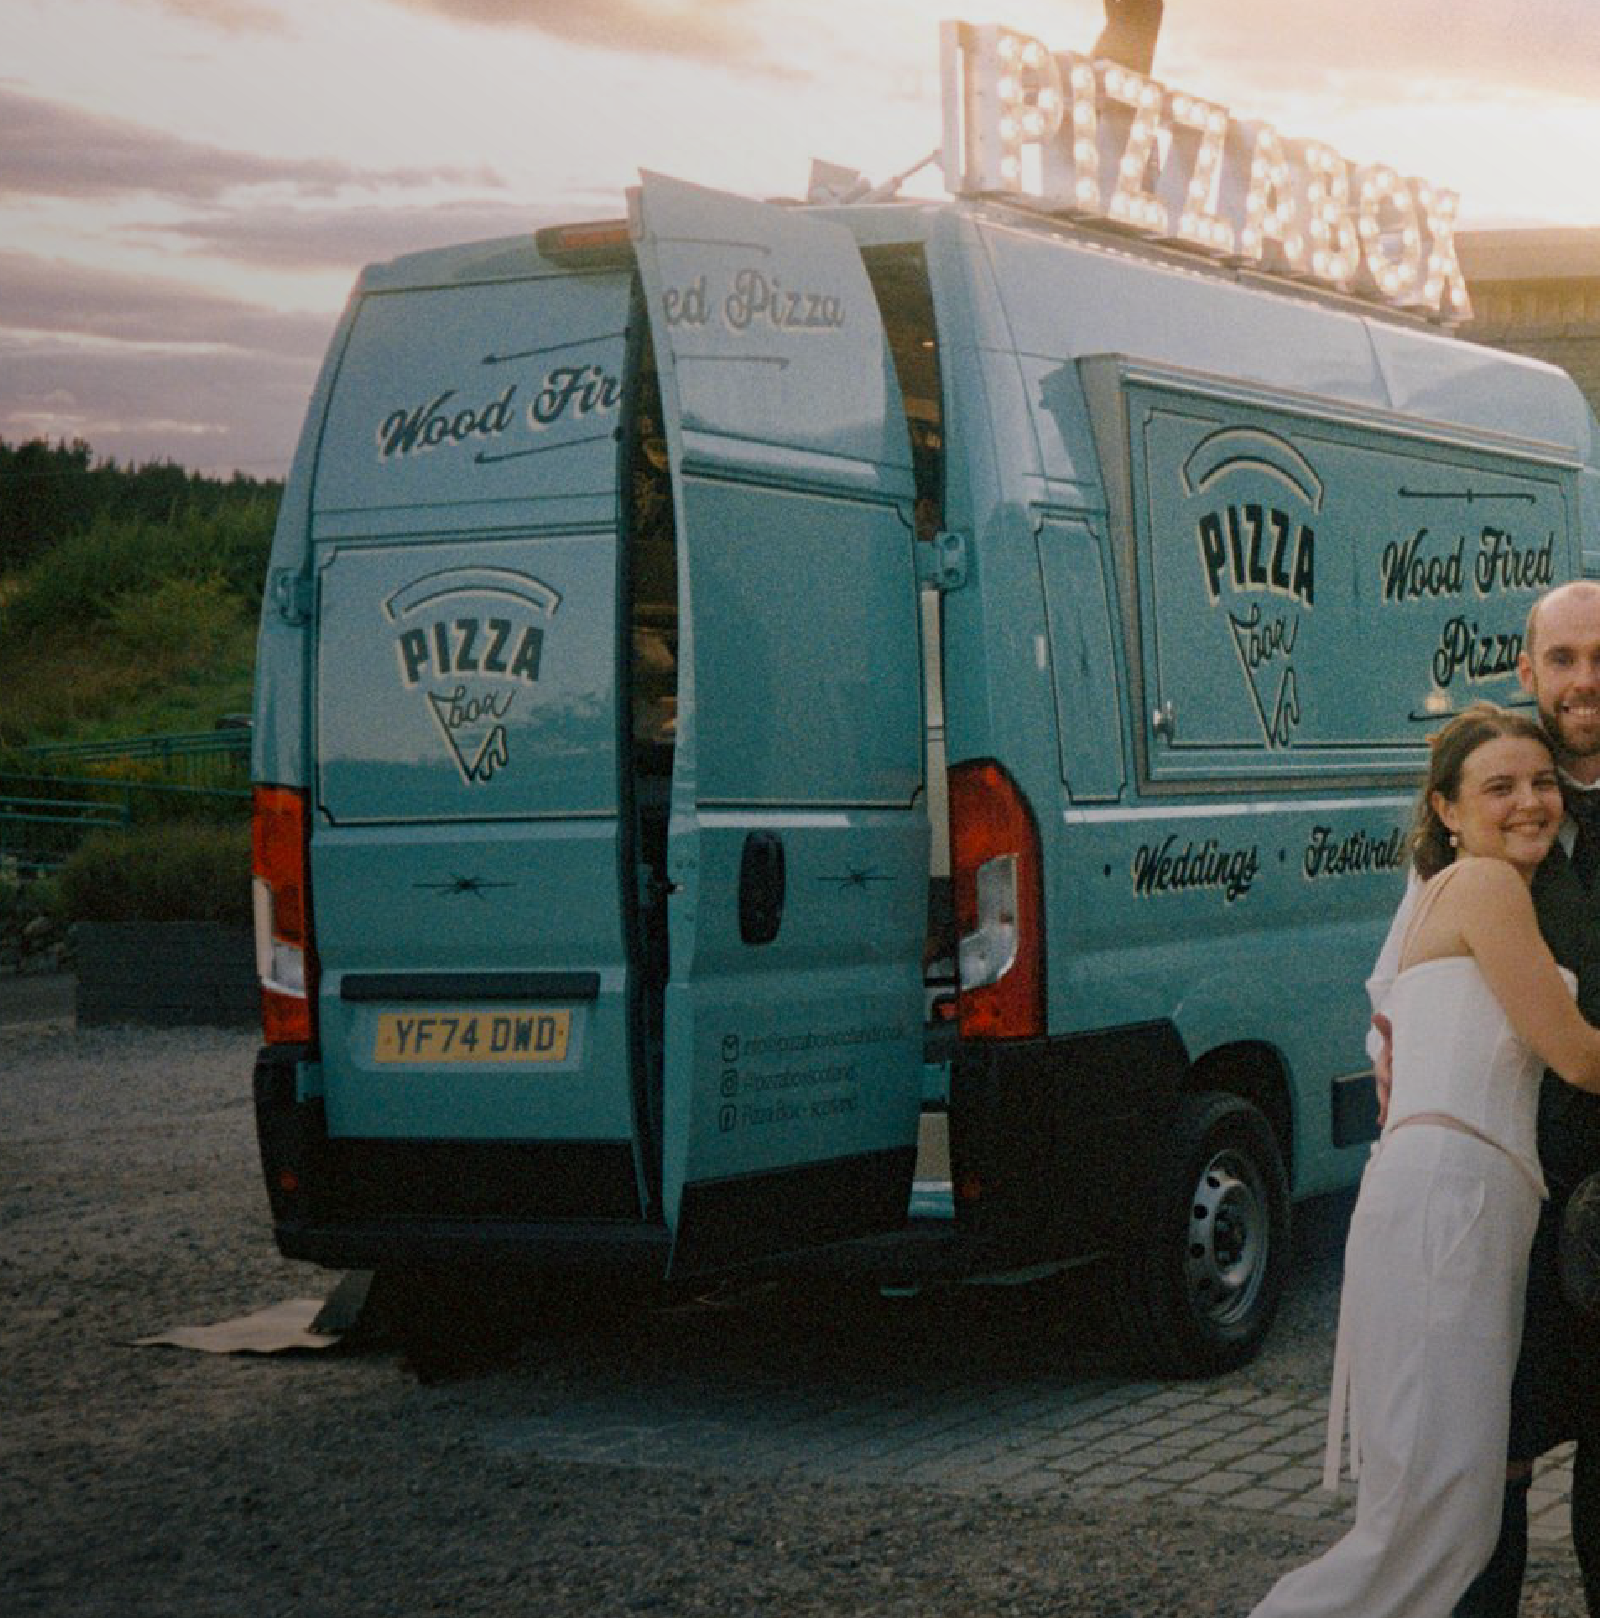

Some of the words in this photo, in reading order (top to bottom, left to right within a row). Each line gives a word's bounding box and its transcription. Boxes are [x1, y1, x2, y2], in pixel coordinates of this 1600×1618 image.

[725, 268, 846, 333] Pizza
[379, 384, 517, 459] Wood
[1198, 502, 1315, 608] PIZZA
[1381, 526, 1466, 604] Wood
[1473, 525, 1556, 595] Fired
[399, 617, 546, 683] PIZZA
[1233, 602, 1300, 668] box
[434, 685, 516, 728] box
[1132, 834, 1261, 903] Weddings
[395, 1017, 479, 1055] YF74
[489, 1015, 557, 1054] DWD
